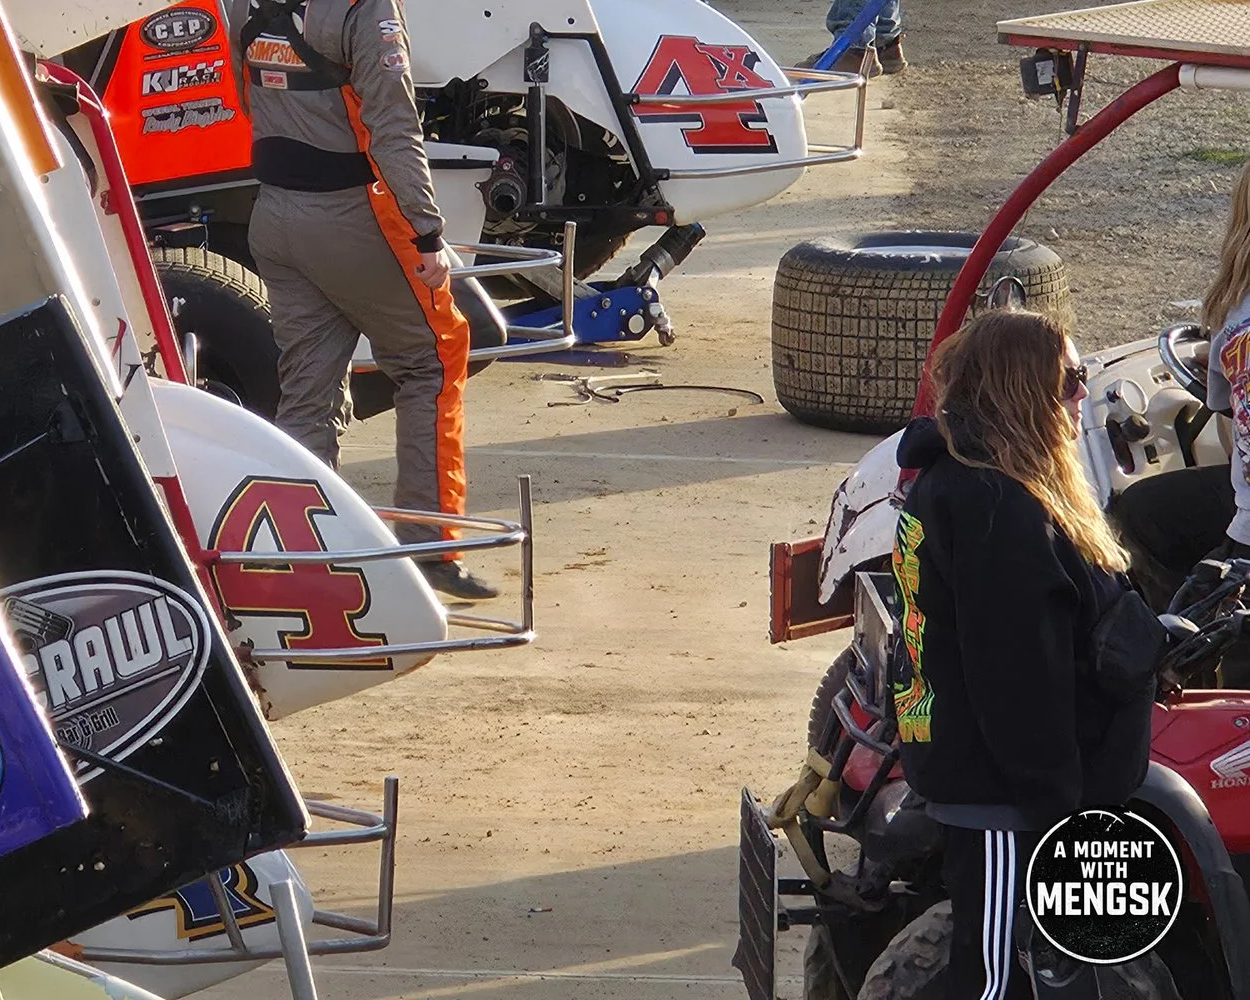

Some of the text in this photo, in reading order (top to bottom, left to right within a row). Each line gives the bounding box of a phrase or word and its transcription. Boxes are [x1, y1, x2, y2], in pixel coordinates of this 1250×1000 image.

[154, 19, 202, 40] CEP
[207, 475, 393, 670] 4
[91, 707, 120, 731] Grill
[1211, 777, 1250, 789] HON
